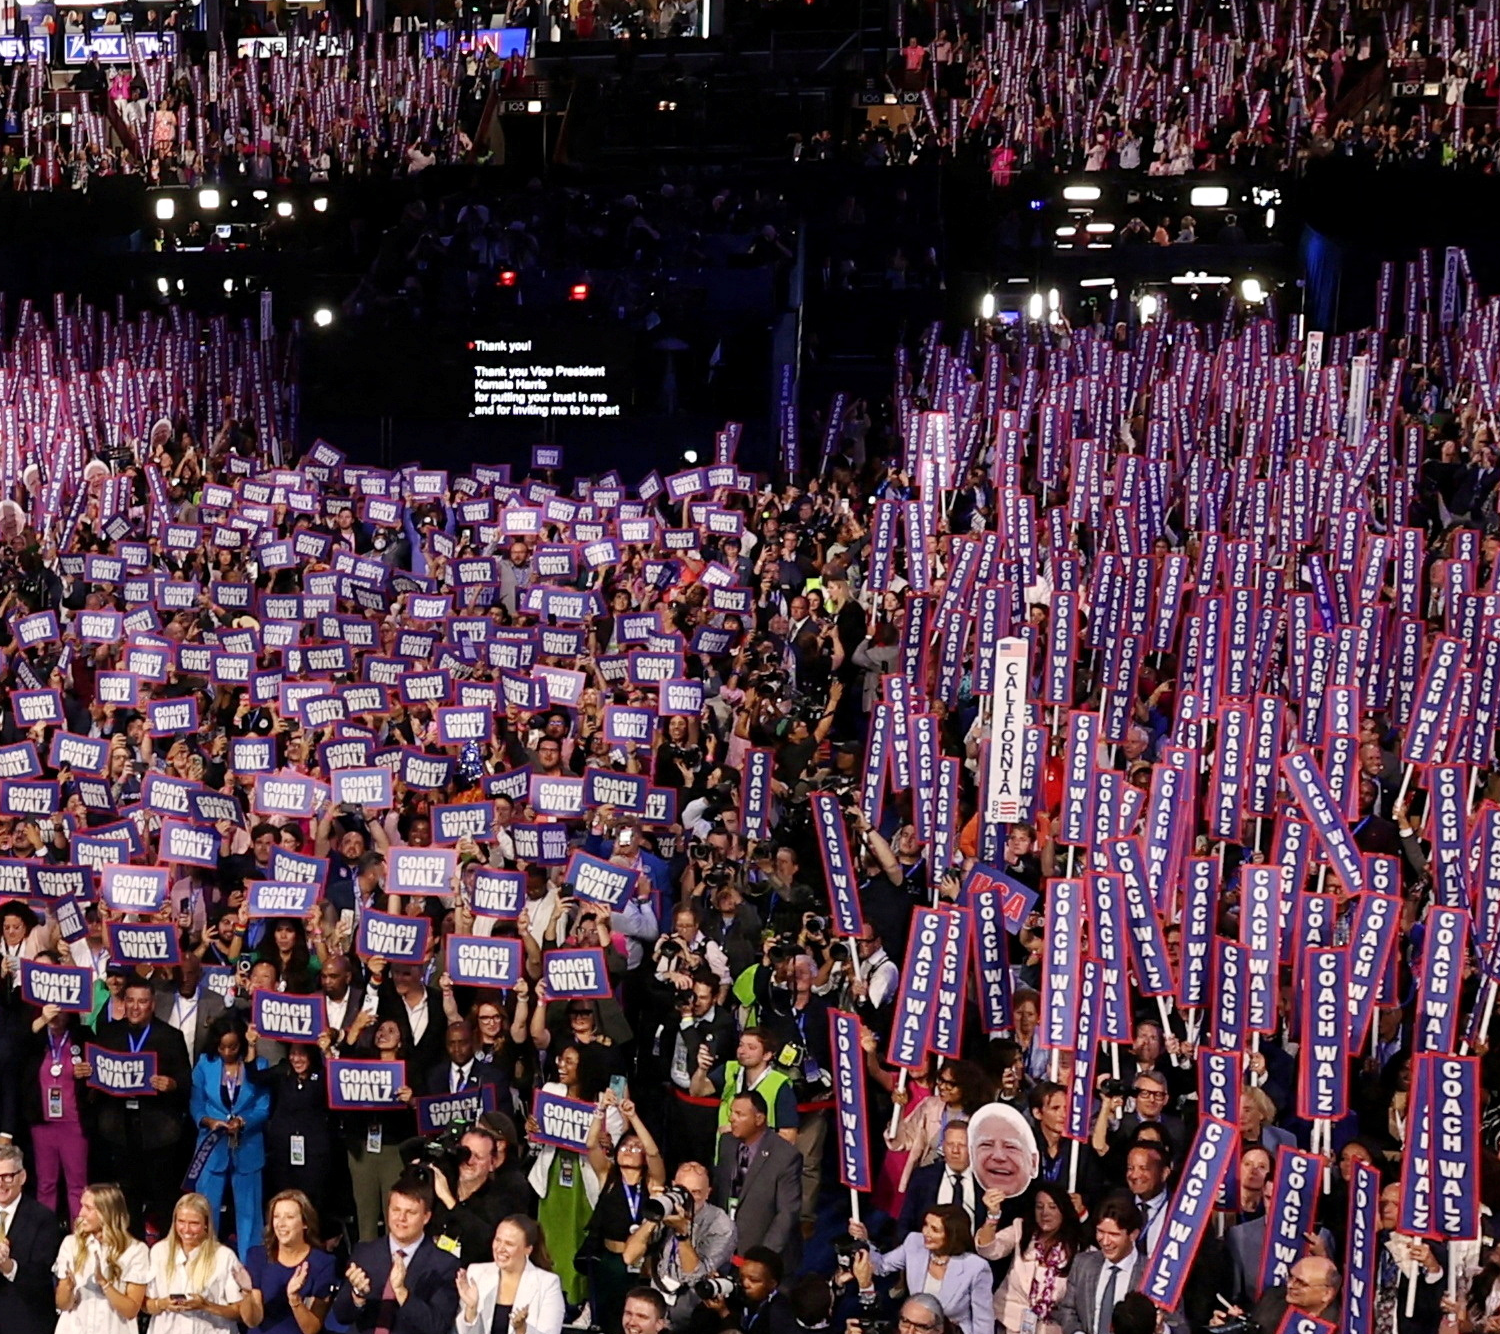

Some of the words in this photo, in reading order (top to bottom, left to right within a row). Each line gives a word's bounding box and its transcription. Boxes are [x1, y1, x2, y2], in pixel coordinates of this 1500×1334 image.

[475, 340, 507, 351] Thank
[509, 340, 531, 353] you!
[475, 366, 507, 377] Thank
[509, 368, 528, 379] you
[530, 366, 553, 377] Vice
[555, 366, 605, 377] President
[516, 379, 547, 390] Harris
[475, 392, 489, 402] for
[491, 392, 526, 405] putting
[528, 394, 550, 405] your
[553, 392, 576, 402] trust
[578, 392, 588, 402] in
[590, 394, 607, 402] me
[475, 405, 494, 415] and
[497, 405, 511, 415] for
[513, 405, 549, 417] inviting
[551, 407, 567, 415] me
[570, 406, 580, 415] to
[583, 405, 596, 415] be
[598, 406, 620, 417] part
[1001, 662, 1017, 795] CALIFORNIA
[113, 873, 158, 890] COACH
[112, 887, 157, 907] WALZ
[368, 919, 416, 937] COACH
[367, 930, 416, 954] WALZ
[262, 999, 312, 1017] COACH
[262, 1012, 312, 1035] WALZ
[1442, 1062, 1463, 1152] COACH
[1439, 1159, 1466, 1232] WALZ
